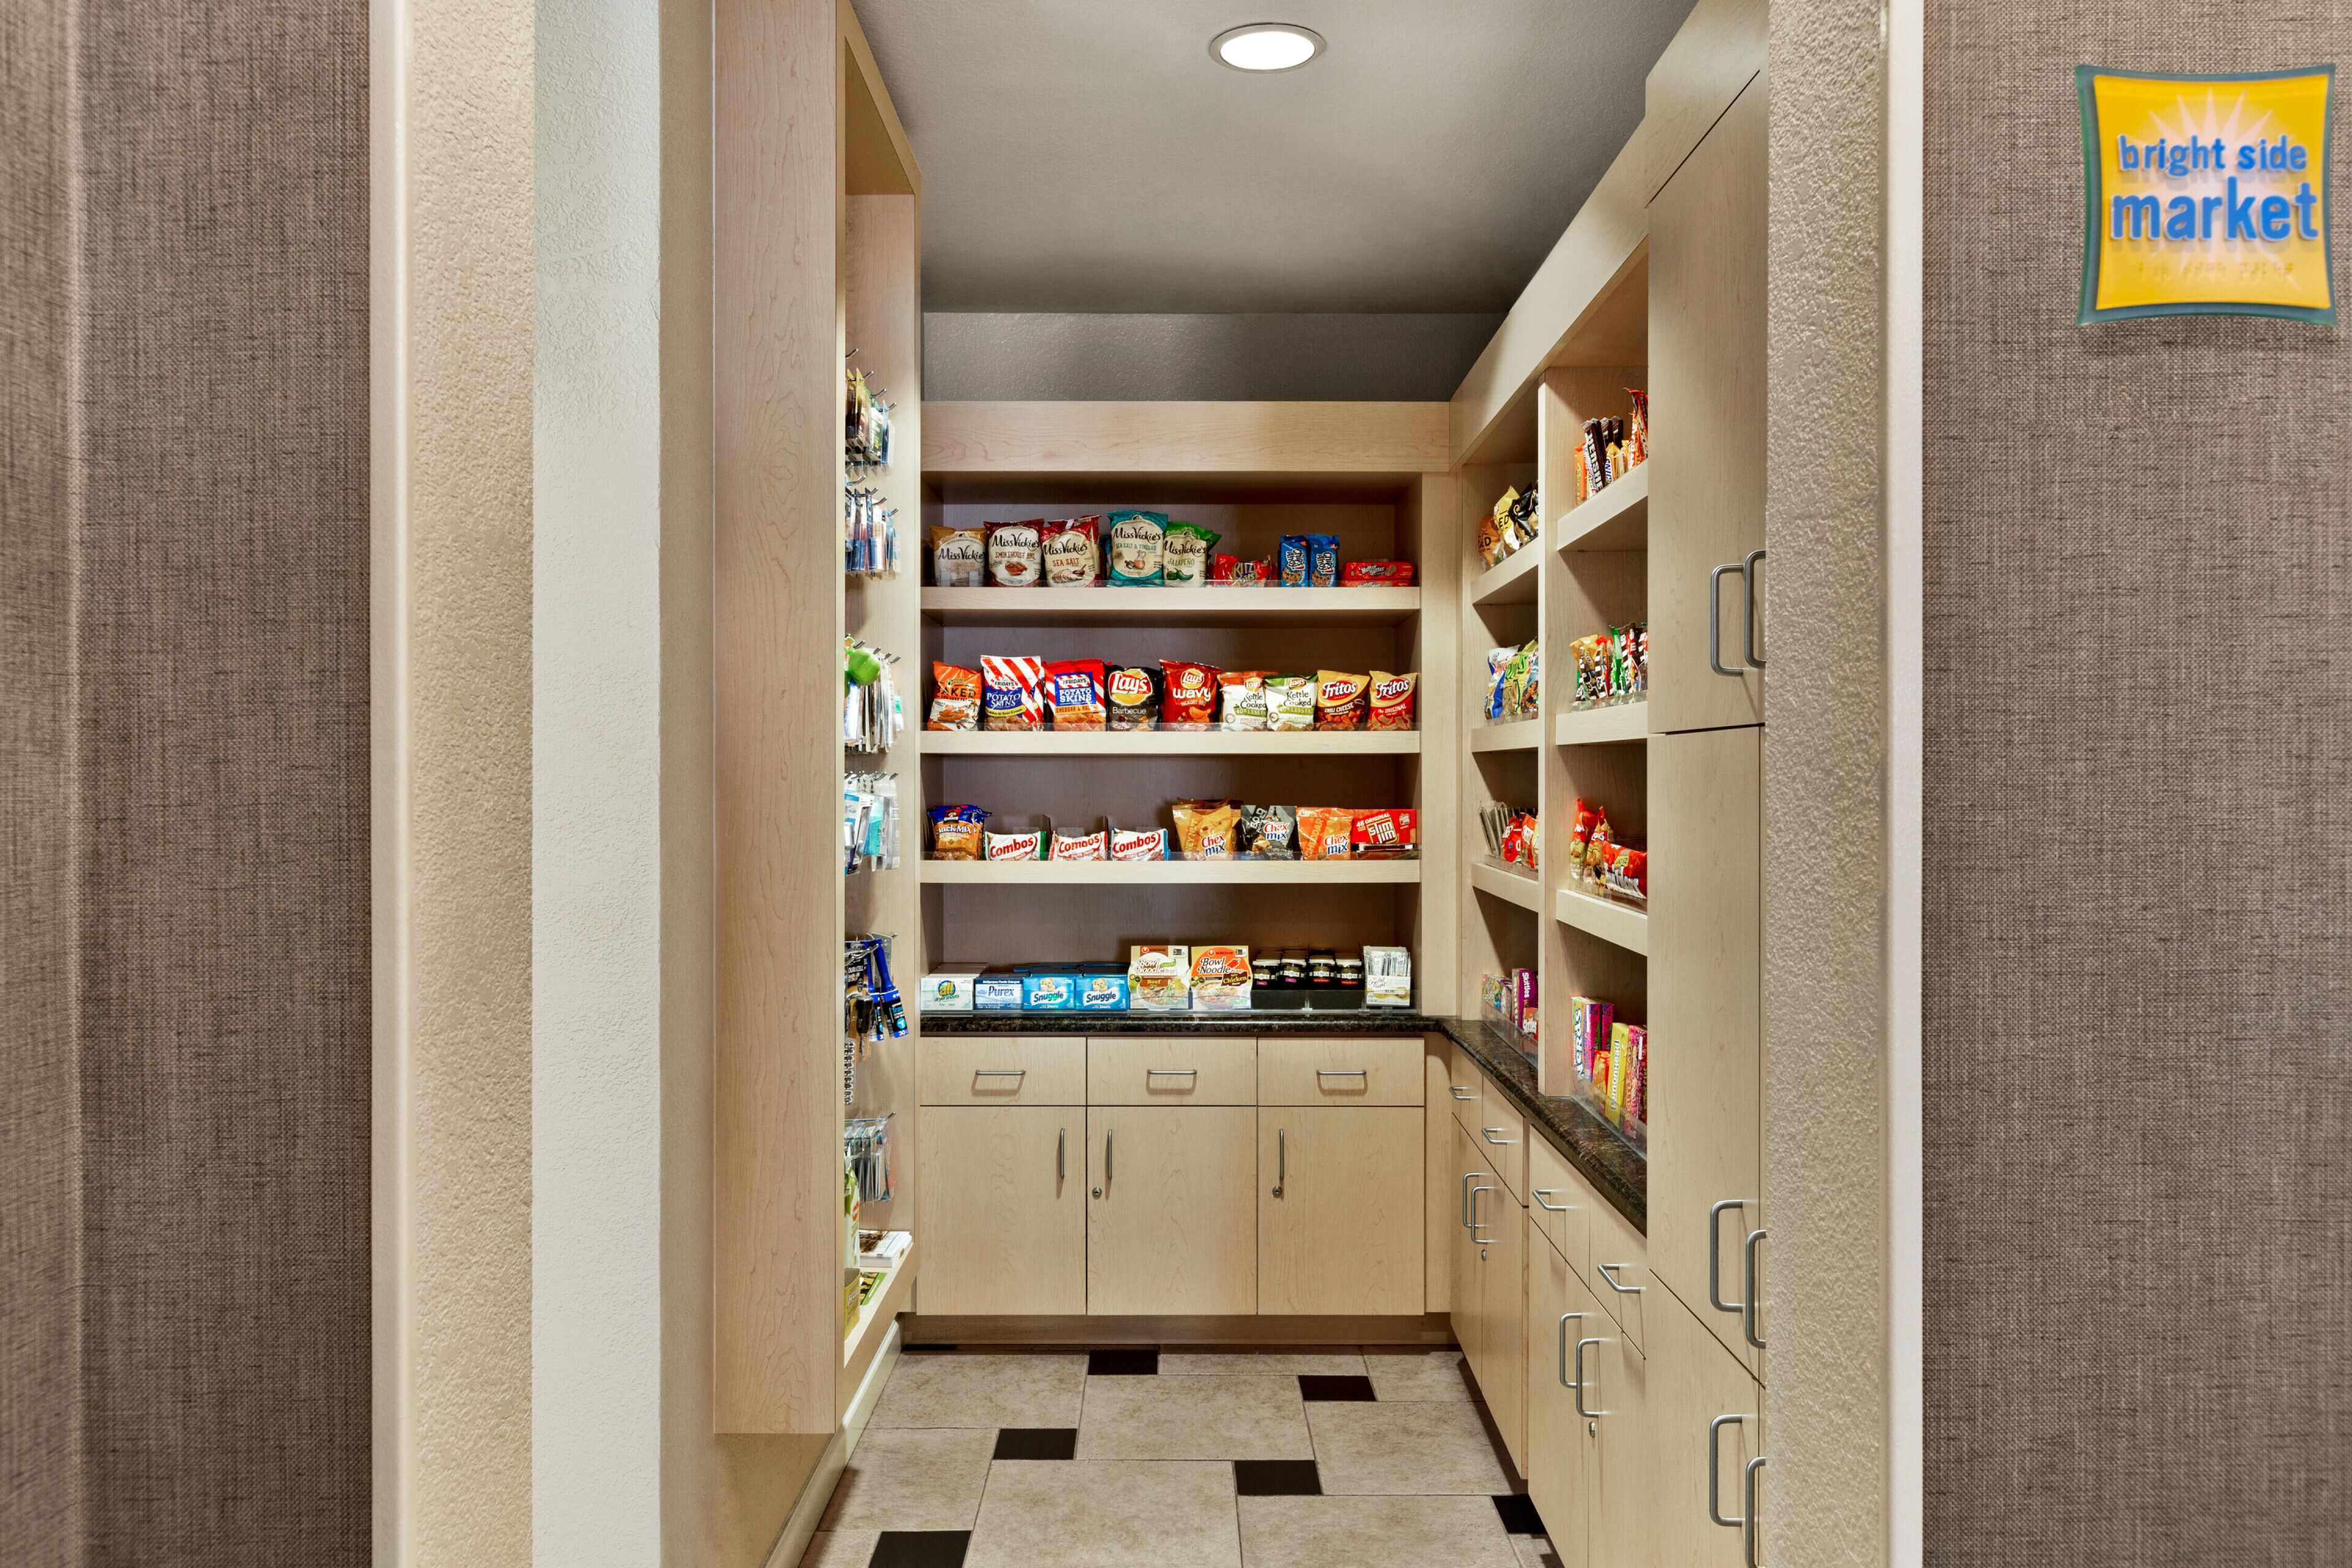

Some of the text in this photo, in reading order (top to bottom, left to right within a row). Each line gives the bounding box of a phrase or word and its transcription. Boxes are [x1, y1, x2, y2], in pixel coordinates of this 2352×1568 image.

[2118, 134, 2308, 178] bright side
[2110, 175, 2320, 241] market
[992, 532, 1039, 551] Miss Vickie's
[1114, 526, 1161, 545] Miss Vickie's
[938, 545, 985, 563] Miss Vickie'
[1043, 543, 1061, 556] Miss
[1164, 540, 1182, 555] Miss
[1292, 549, 1303, 566] Chips
[1323, 552, 1333, 570] Chips
[1234, 562, 1254, 578] RITZ
[1361, 565, 1377, 574] Nutter
[1370, 567, 1385, 576] Butter
[1111, 673, 1148, 694] Lay's
[1183, 671, 1205, 684] Lay's
[937, 685, 976, 698] BAKED
[1173, 686, 1211, 702] wavy
[1287, 690, 1309, 700] Kettle
[1322, 680, 1356, 699] Fritos
[1376, 680, 1409, 699] Fritos
[987, 693, 1021, 702] POTATO
[1060, 694, 1091, 703] SKINS
[1245, 692, 1263, 702] Kettle
[1283, 698, 1311, 707] Cooked
[1112, 706, 1147, 715] Barbecue
[1336, 703, 1354, 712] CHEESE
[1385, 703, 1406, 714] ORIGINAL
[1365, 812, 1391, 824] ORIGINAL
[956, 825, 971, 835] Mix
[1264, 823, 1289, 832] Chex
[1112, 832, 1156, 854] Combos
[1201, 833, 1225, 848] Chex
[1305, 818, 1323, 858] CHEDDAR
[1324, 833, 1348, 846] Chex
[990, 837, 1035, 858] Combos
[1205, 842, 1226, 857] mix
[1328, 841, 1348, 854] mix
[1200, 957, 1226, 967] Bowl
[1197, 965, 1231, 975] Noodle
[939, 981, 954, 996] all
[988, 985, 1015, 997] Purex
[1033, 991, 1064, 1003] Snuggle
[1086, 991, 1116, 1003] Snuggle
